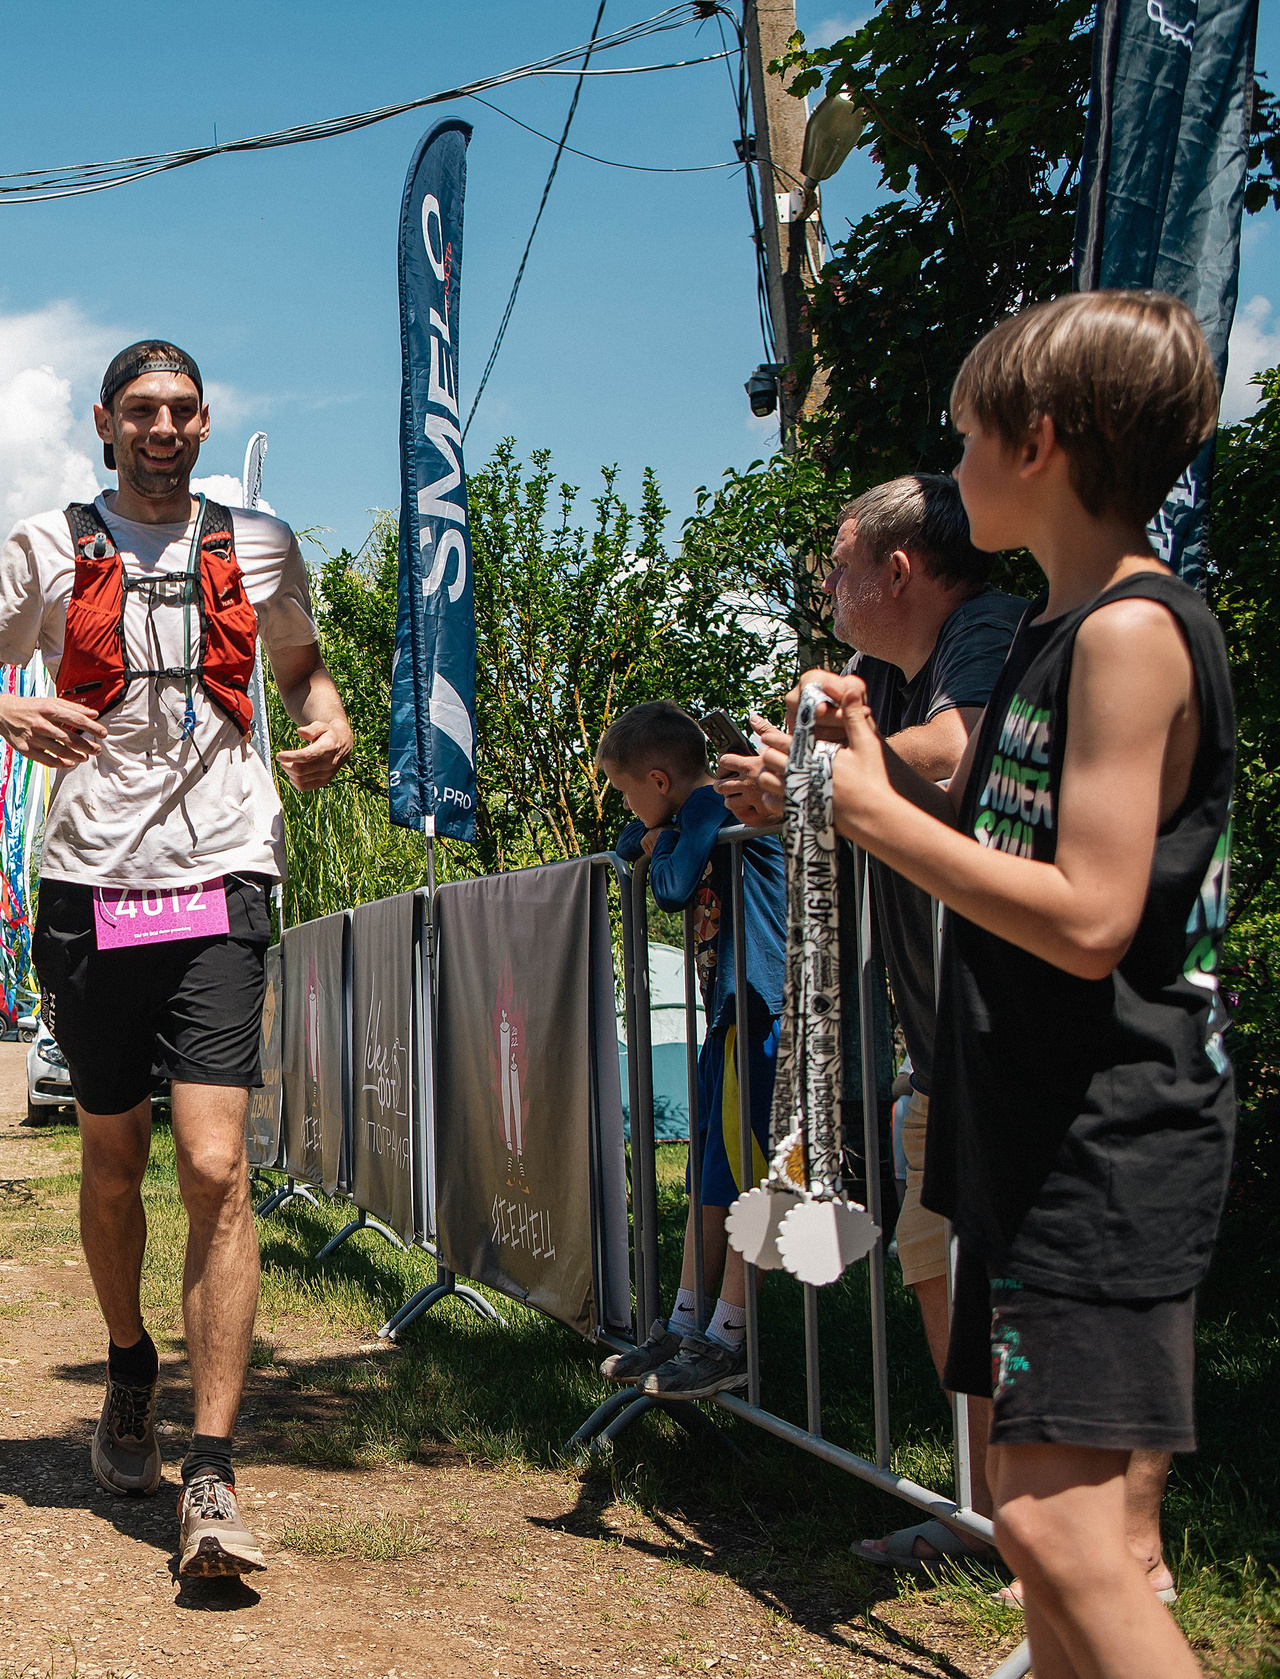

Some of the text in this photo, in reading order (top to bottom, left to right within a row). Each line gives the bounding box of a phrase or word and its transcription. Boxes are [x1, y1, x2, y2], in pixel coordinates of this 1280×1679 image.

[980, 754, 1053, 830] RIDER
[115, 882, 207, 919] 4012
[809, 898, 833, 924] 46
